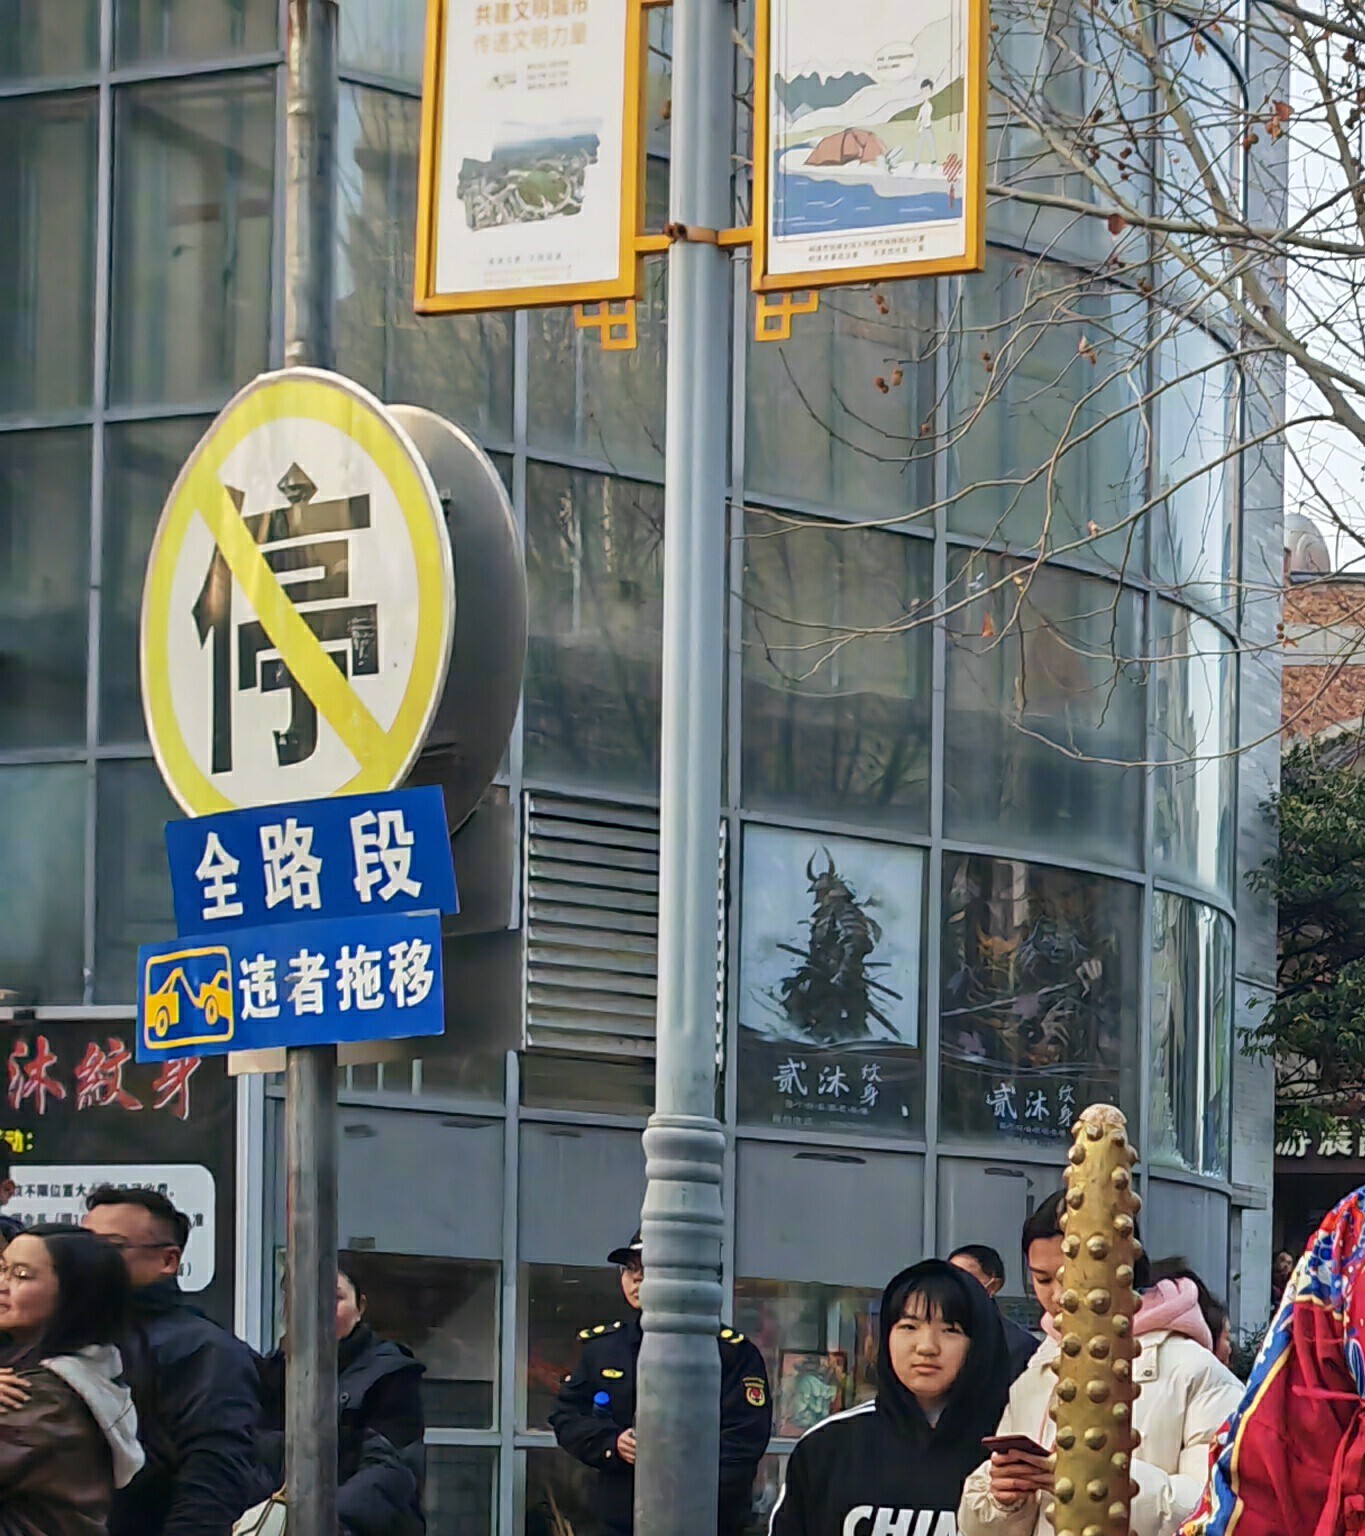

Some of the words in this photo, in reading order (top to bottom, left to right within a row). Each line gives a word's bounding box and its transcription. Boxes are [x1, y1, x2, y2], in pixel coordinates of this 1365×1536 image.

[192, 462, 379, 775] 停
[195, 809, 422, 920] 全路段
[238, 938, 434, 1020] 违者拖移
